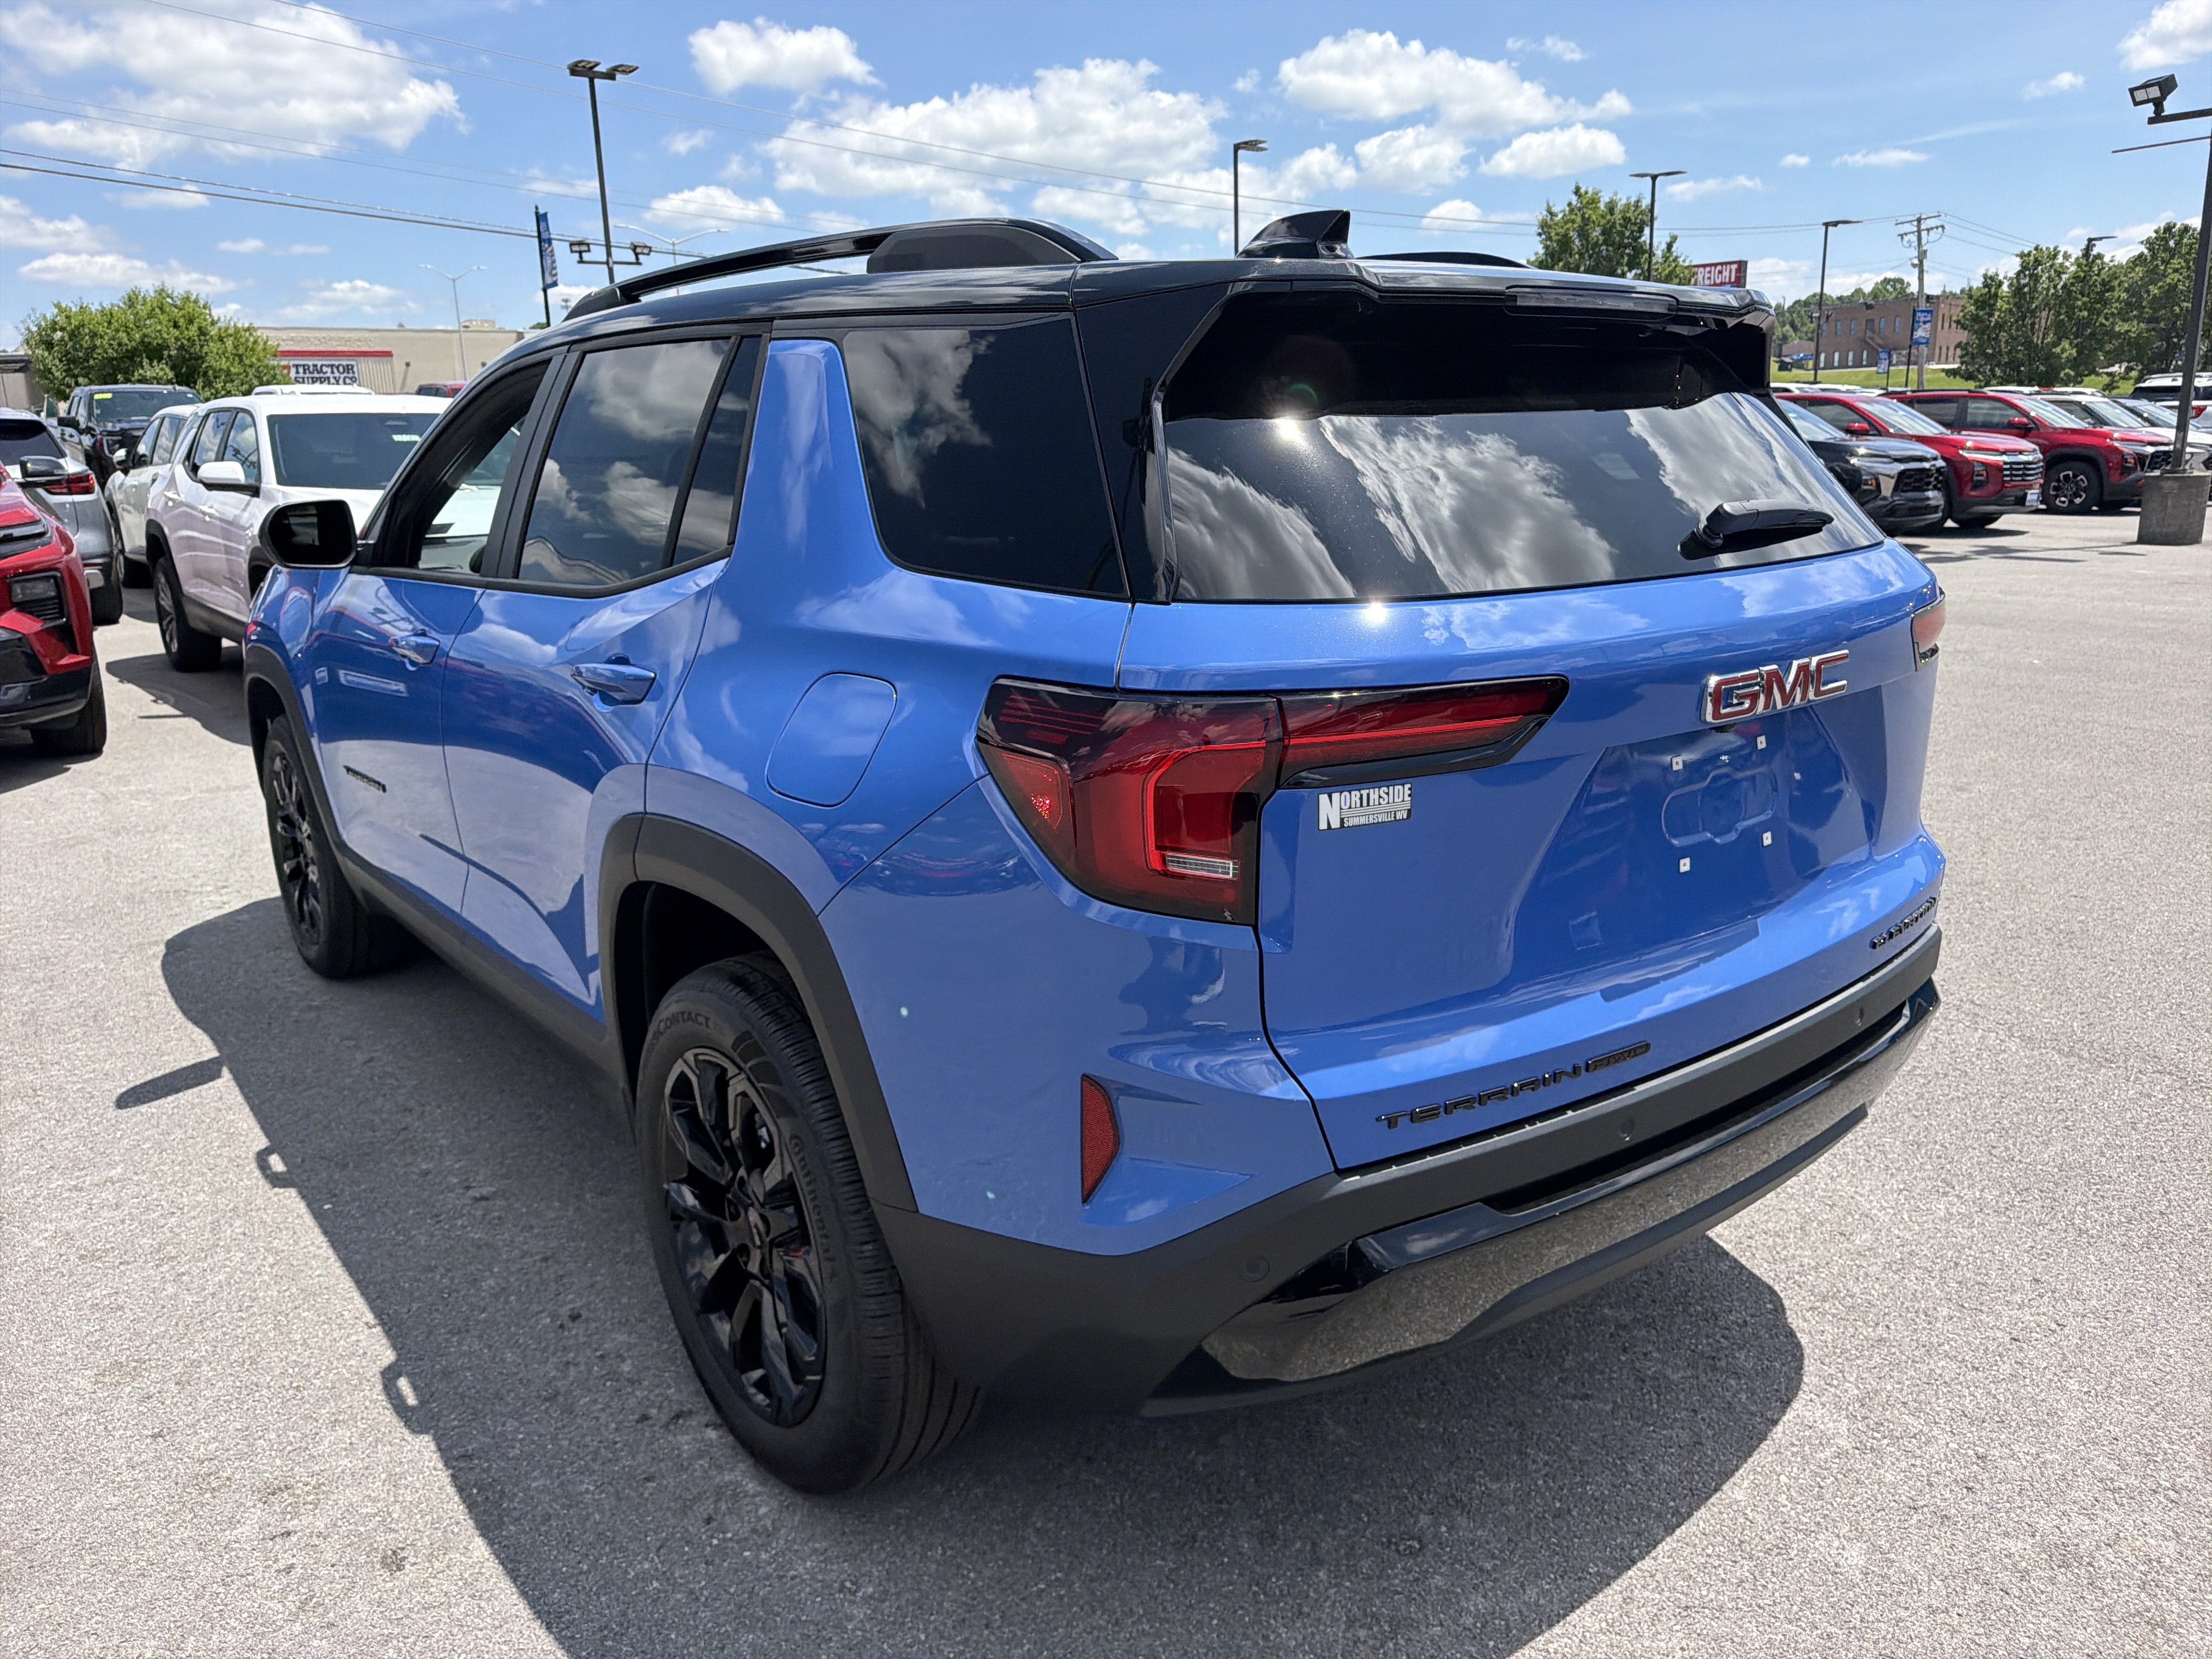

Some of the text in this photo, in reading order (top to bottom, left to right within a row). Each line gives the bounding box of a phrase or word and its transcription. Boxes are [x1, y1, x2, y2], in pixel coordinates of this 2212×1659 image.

[292, 364, 356, 375] TRACTOR
[294, 376, 341, 385] SUPPLY
[1704, 650, 1849, 723] GMC
[1319, 783, 1412, 830] NORTHSIDE
[1344, 809, 1408, 827] SUMMERSVILLE WV
[1375, 1063, 1582, 1129] TERRAIN
